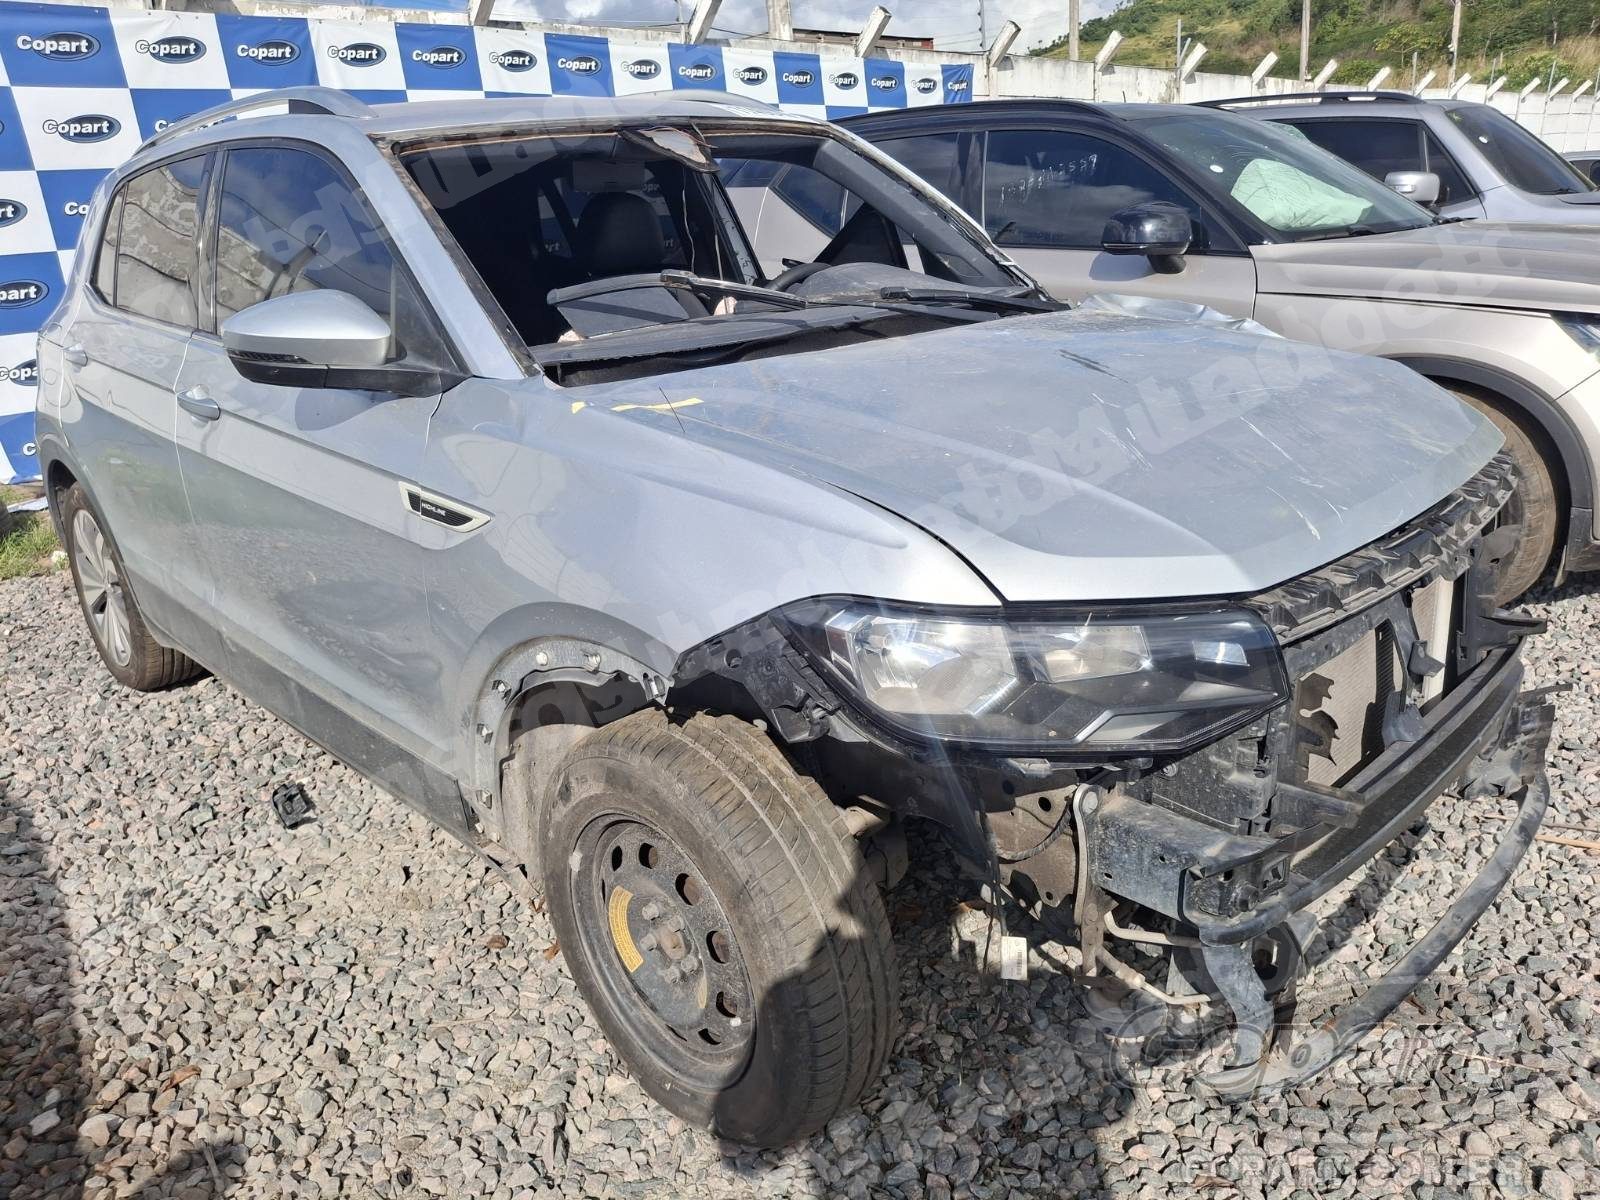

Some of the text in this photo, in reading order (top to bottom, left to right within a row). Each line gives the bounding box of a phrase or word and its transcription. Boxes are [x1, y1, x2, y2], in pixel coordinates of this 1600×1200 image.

[17, 35, 89, 55] Copart
[136, 40, 197, 57] Copart
[237, 44, 292, 60] Copart
[328, 46, 378, 60] Copart
[412, 50, 459, 63] Copart
[490, 52, 530, 66] Copart
[558, 58, 597, 71] Copart
[621, 61, 656, 73] Copart
[678, 66, 712, 77] Copart
[734, 68, 763, 81] Copart
[782, 73, 811, 83] Copart
[829, 74, 855, 85] Copart
[871, 78, 896, 88] Copart
[911, 80, 934, 89] Copart
[43, 119, 110, 135] Copart
[0, 285, 37, 303] part
